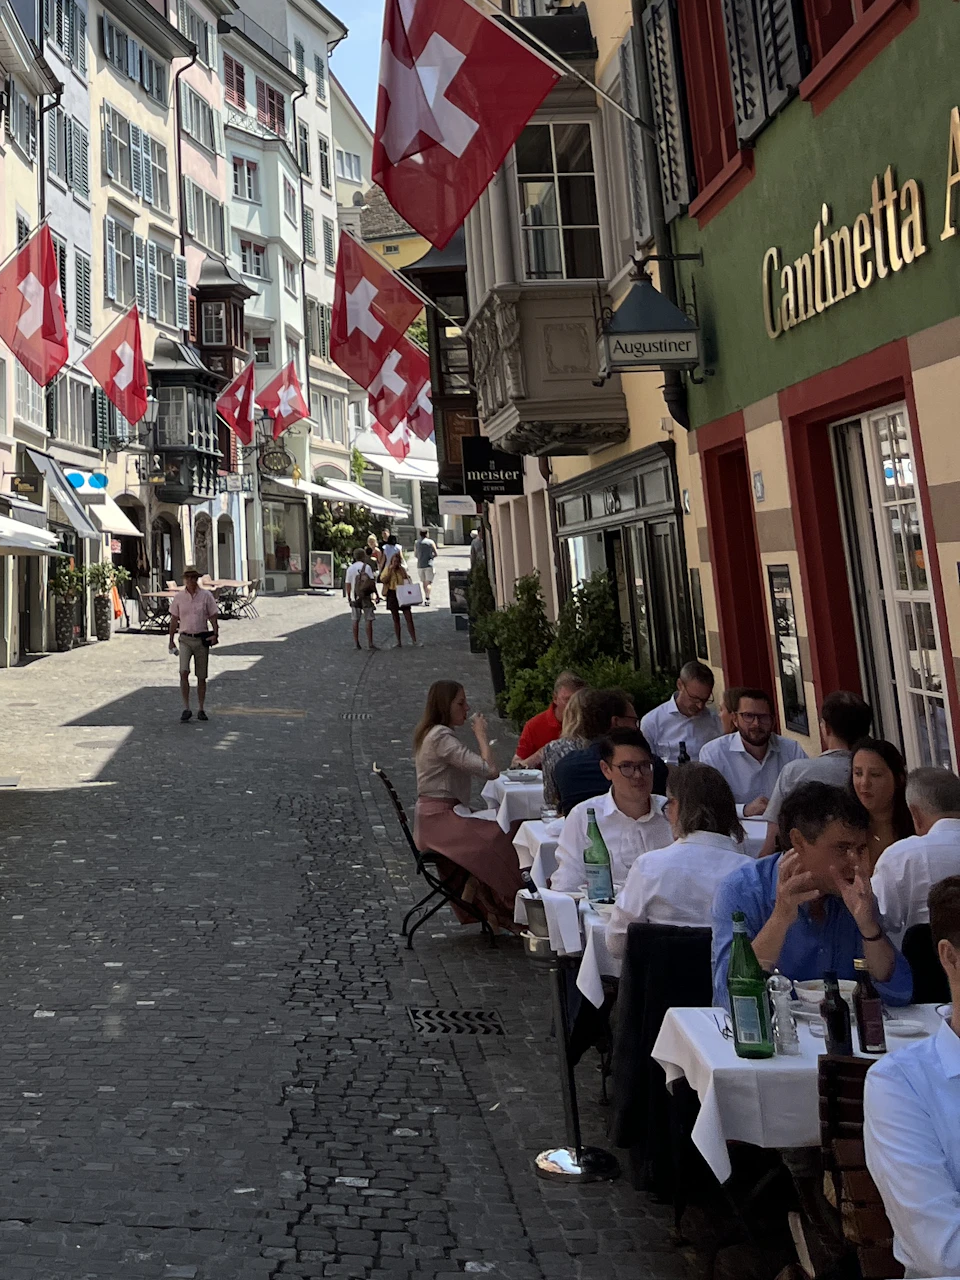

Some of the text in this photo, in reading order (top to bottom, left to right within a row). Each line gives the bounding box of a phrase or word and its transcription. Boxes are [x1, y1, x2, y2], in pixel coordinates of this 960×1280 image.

[762, 164, 926, 339] Cantinetta
[613, 338, 692, 358] Augustiner
[467, 469, 520, 481] meister
